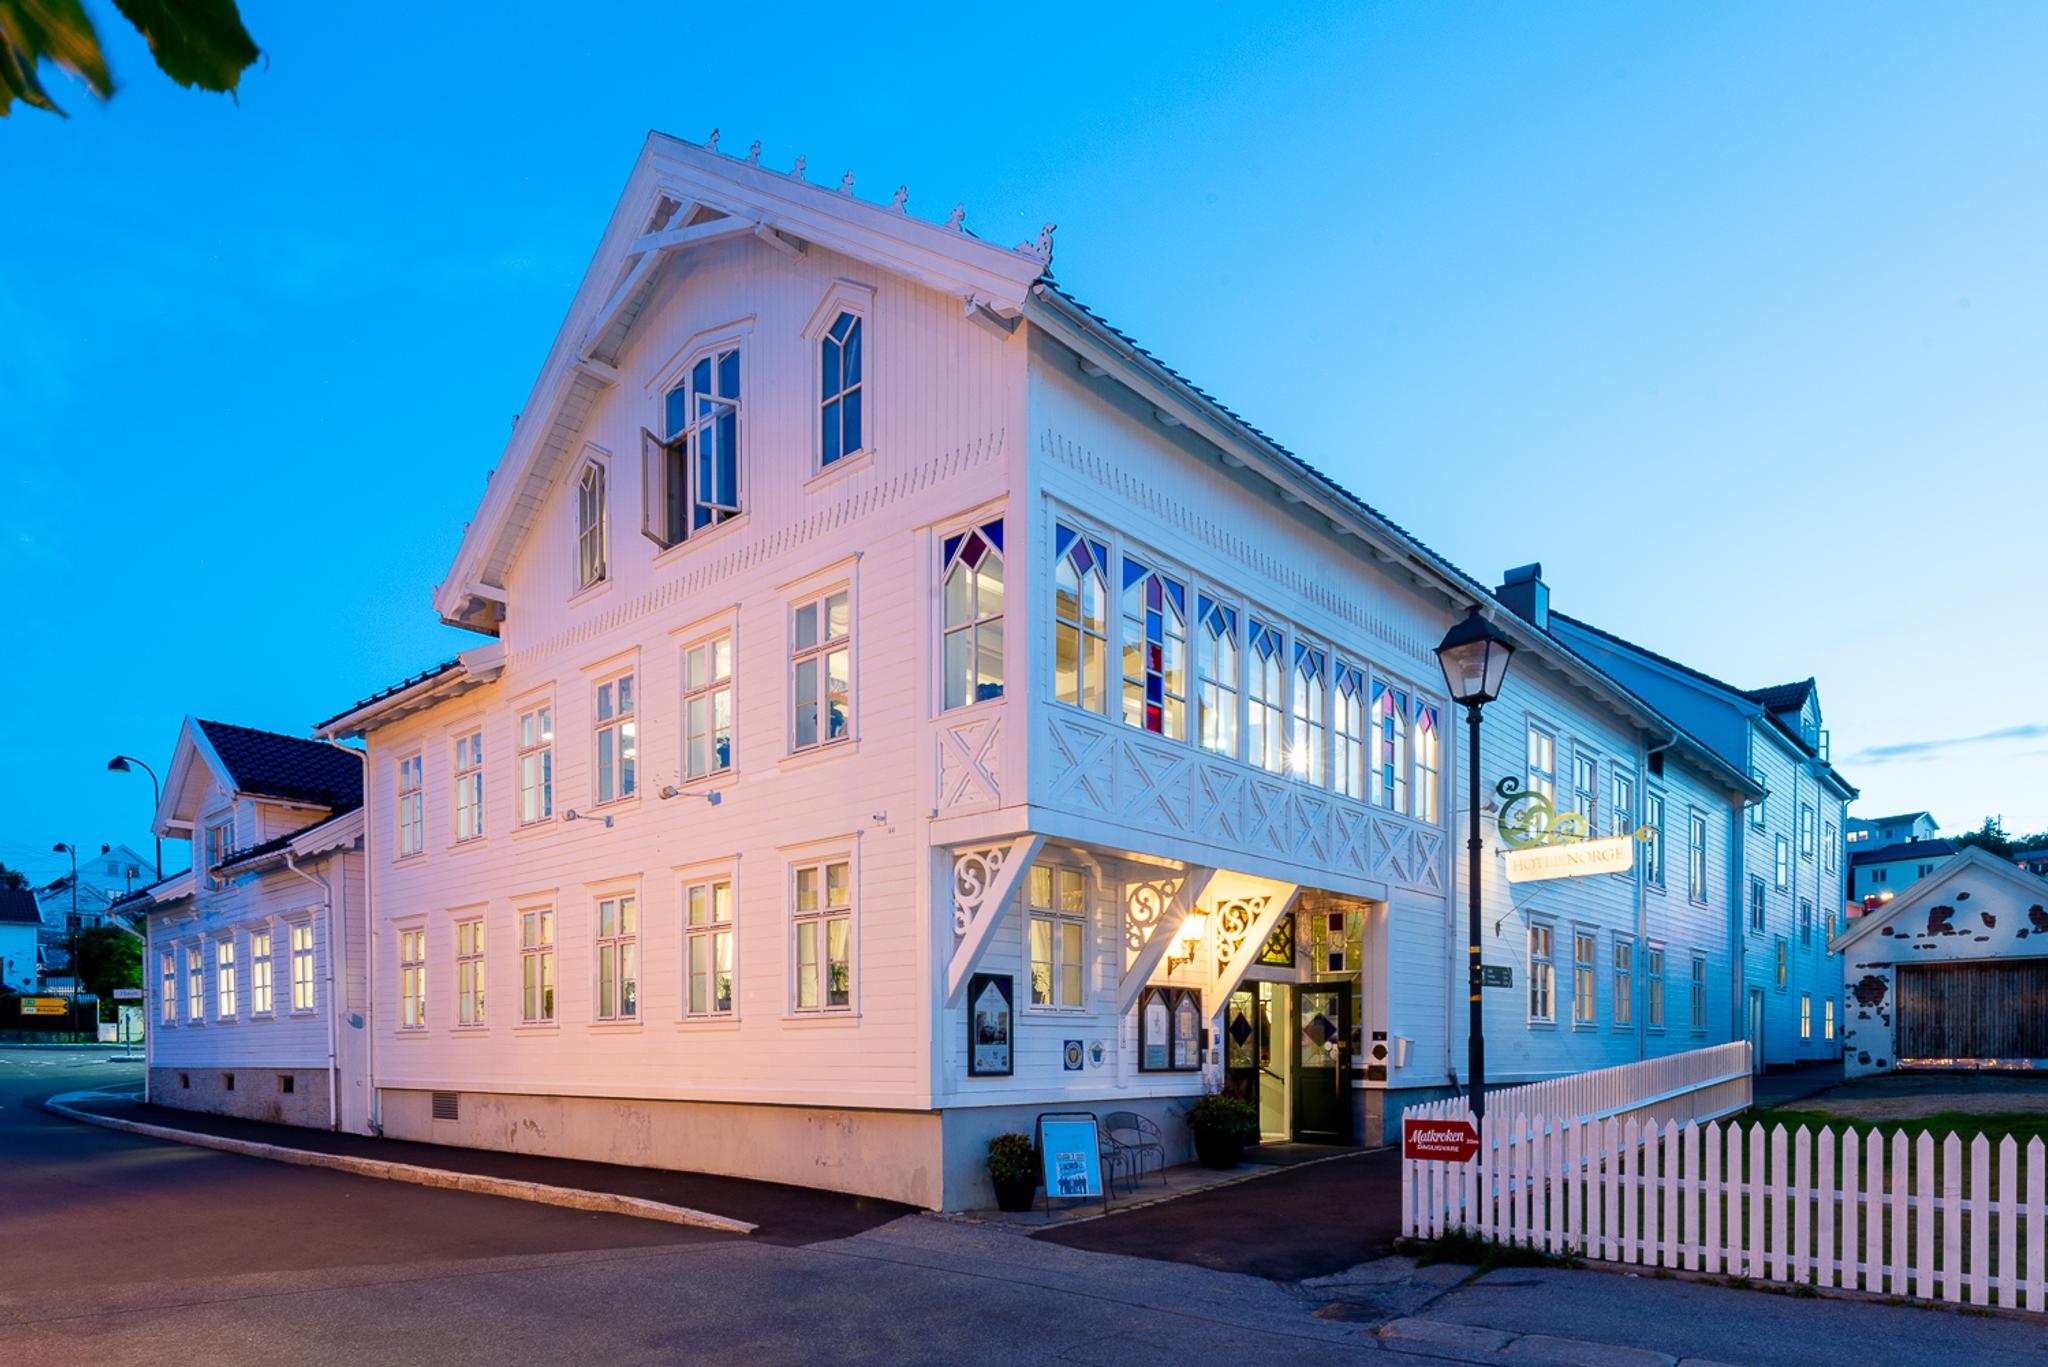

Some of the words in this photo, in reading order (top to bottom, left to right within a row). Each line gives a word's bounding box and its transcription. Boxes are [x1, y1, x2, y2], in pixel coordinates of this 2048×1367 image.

[1512, 855, 1563, 872] HOTEL
[1565, 847, 1624, 866] NORGE
[1408, 1129, 1464, 1144] Matkroken
